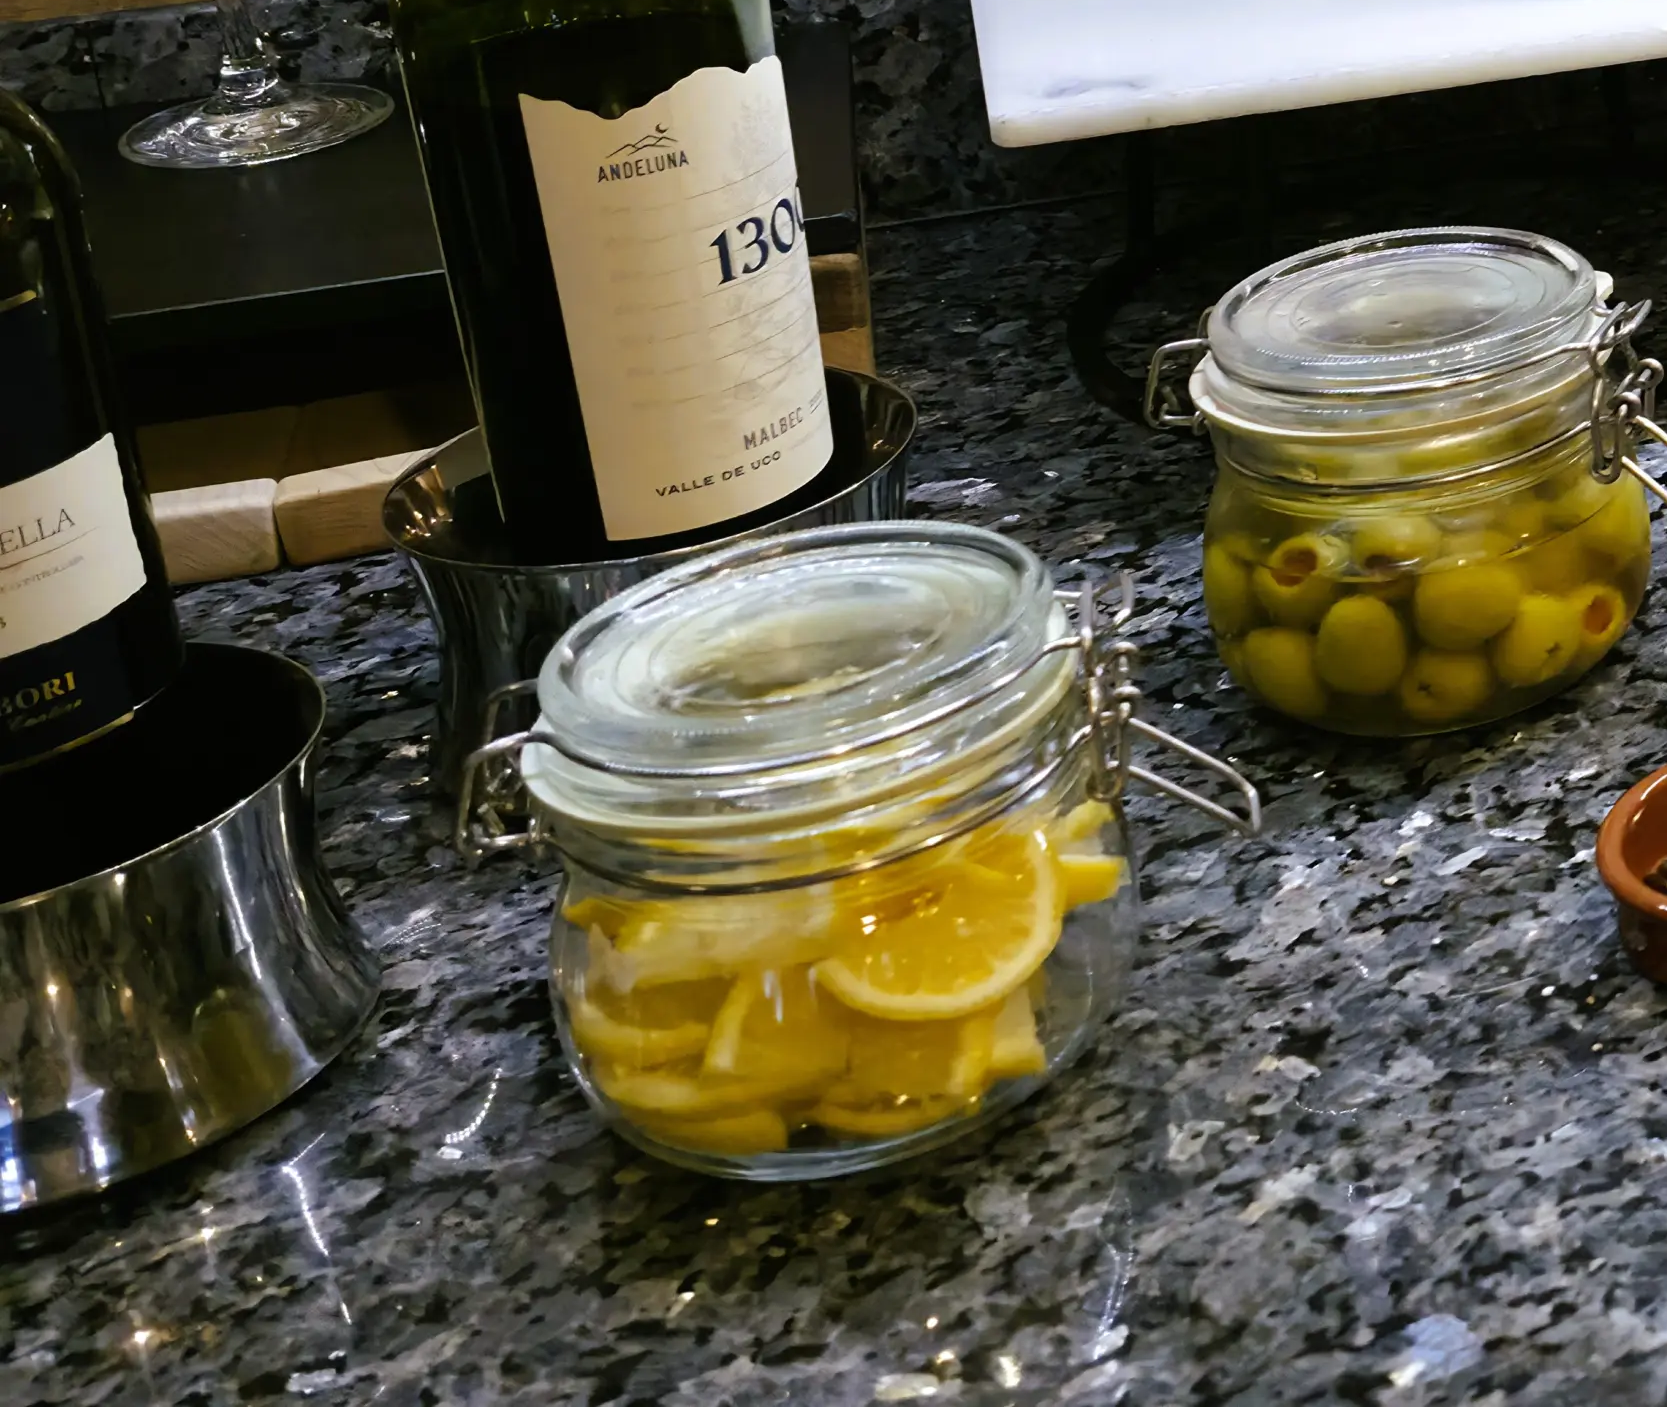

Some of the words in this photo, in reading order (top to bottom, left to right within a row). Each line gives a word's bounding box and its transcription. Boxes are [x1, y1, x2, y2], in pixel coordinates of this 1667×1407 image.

[597, 150, 690, 184] ANDELUNA
[743, 405, 804, 451] MALBEC
[655, 474, 715, 498] VALLE
[722, 464, 745, 481] DE
[750, 450, 782, 471] UCO
